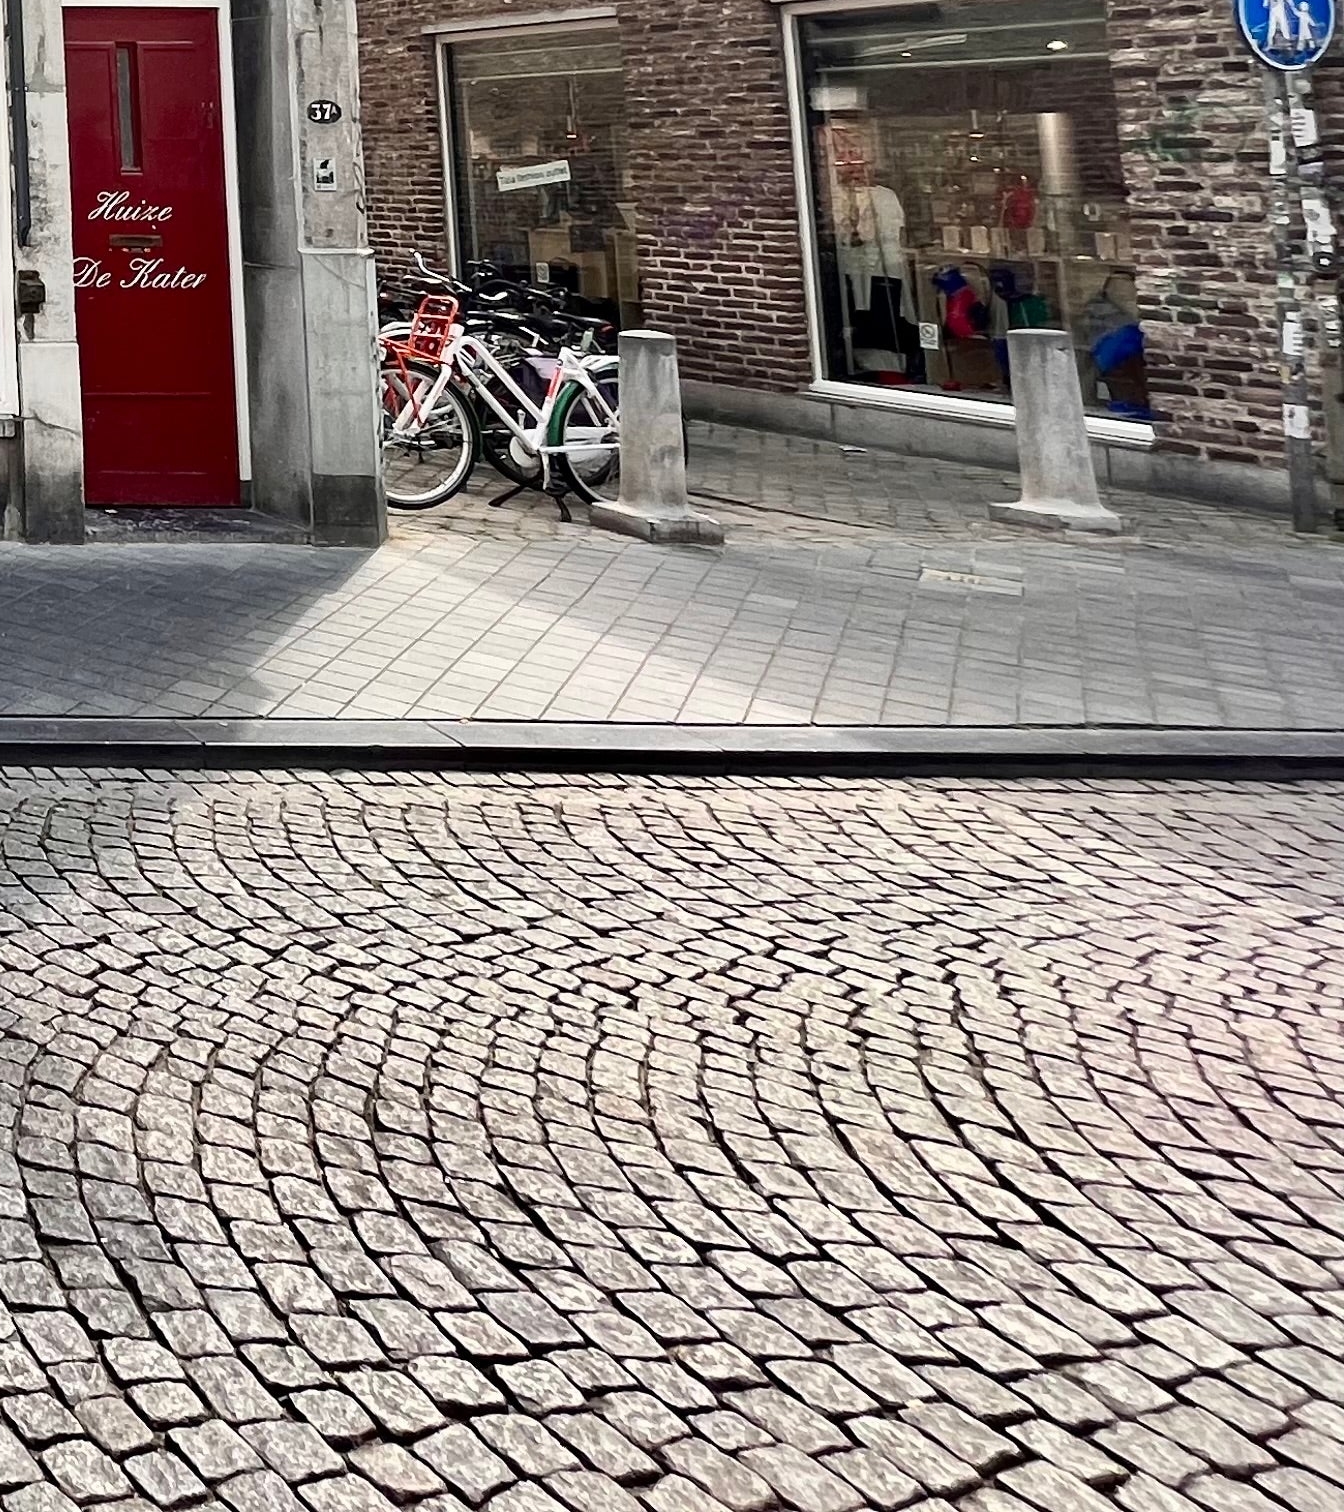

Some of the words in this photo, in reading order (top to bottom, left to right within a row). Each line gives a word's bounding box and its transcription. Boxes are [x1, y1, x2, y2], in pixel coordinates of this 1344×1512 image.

[87, 190, 173, 221] Huize
[72, 256, 111, 288] De
[119, 257, 207, 289] Kater
